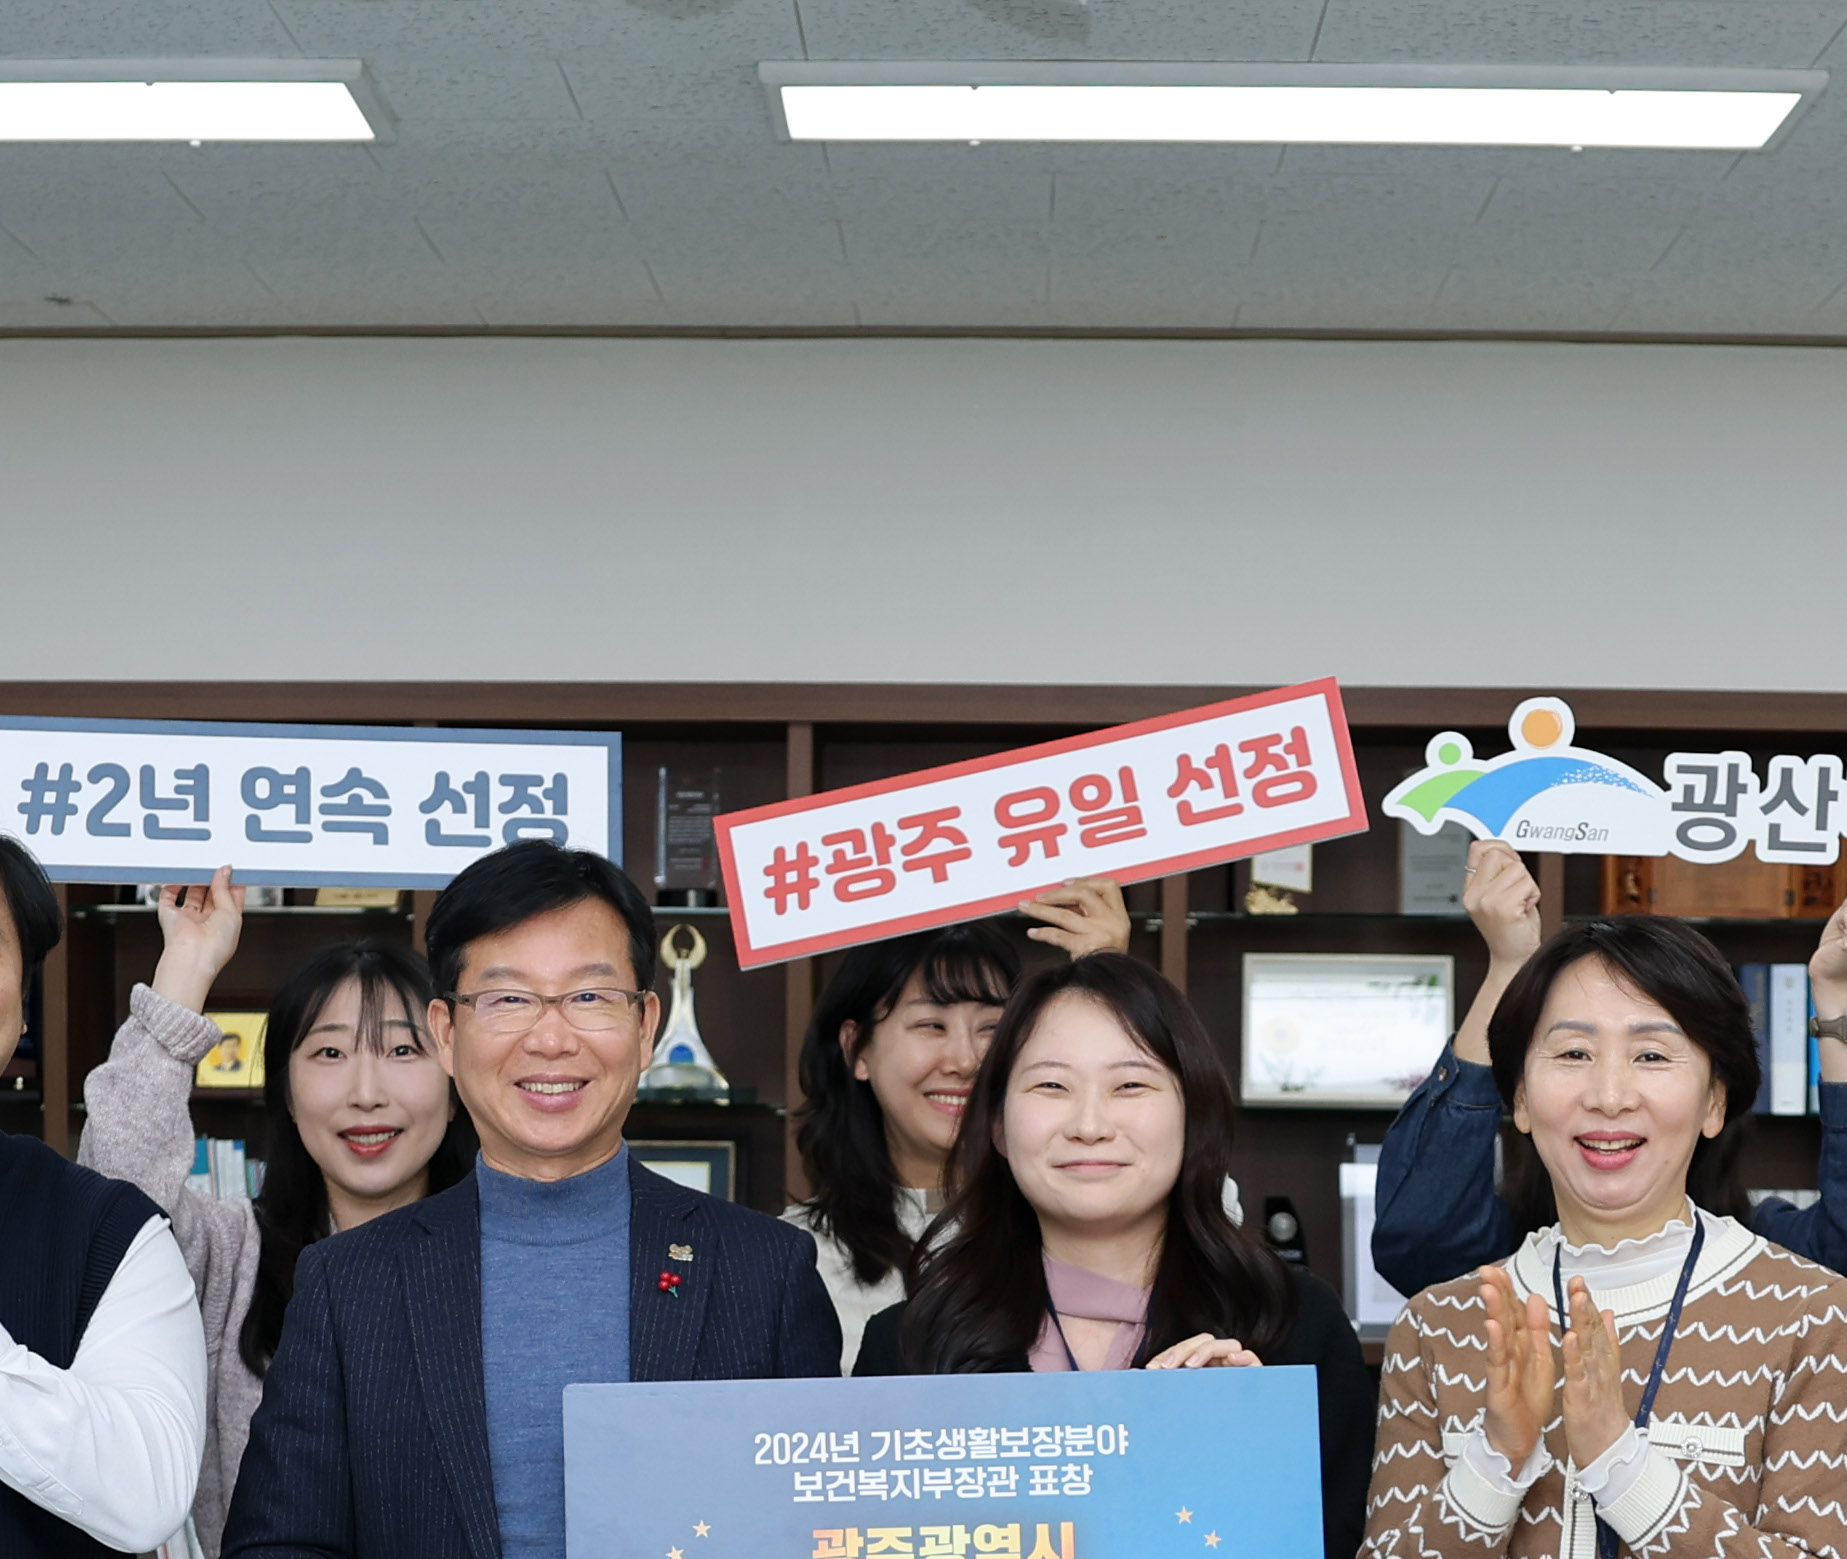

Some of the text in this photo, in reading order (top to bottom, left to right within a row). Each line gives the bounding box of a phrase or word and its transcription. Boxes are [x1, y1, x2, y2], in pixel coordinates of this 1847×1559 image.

[17, 761, 569, 847] #2년 연속 선정
[763, 806, 972, 915] #광주
[994, 766, 1147, 867] 유일
[1167, 726, 1317, 826] 선정
[1516, 820, 1609, 842] GwangSan
[754, 1423, 1128, 1465] 2024년 기초생활보장분야
[793, 1463, 1094, 1503] 보건복지부장관 표창
